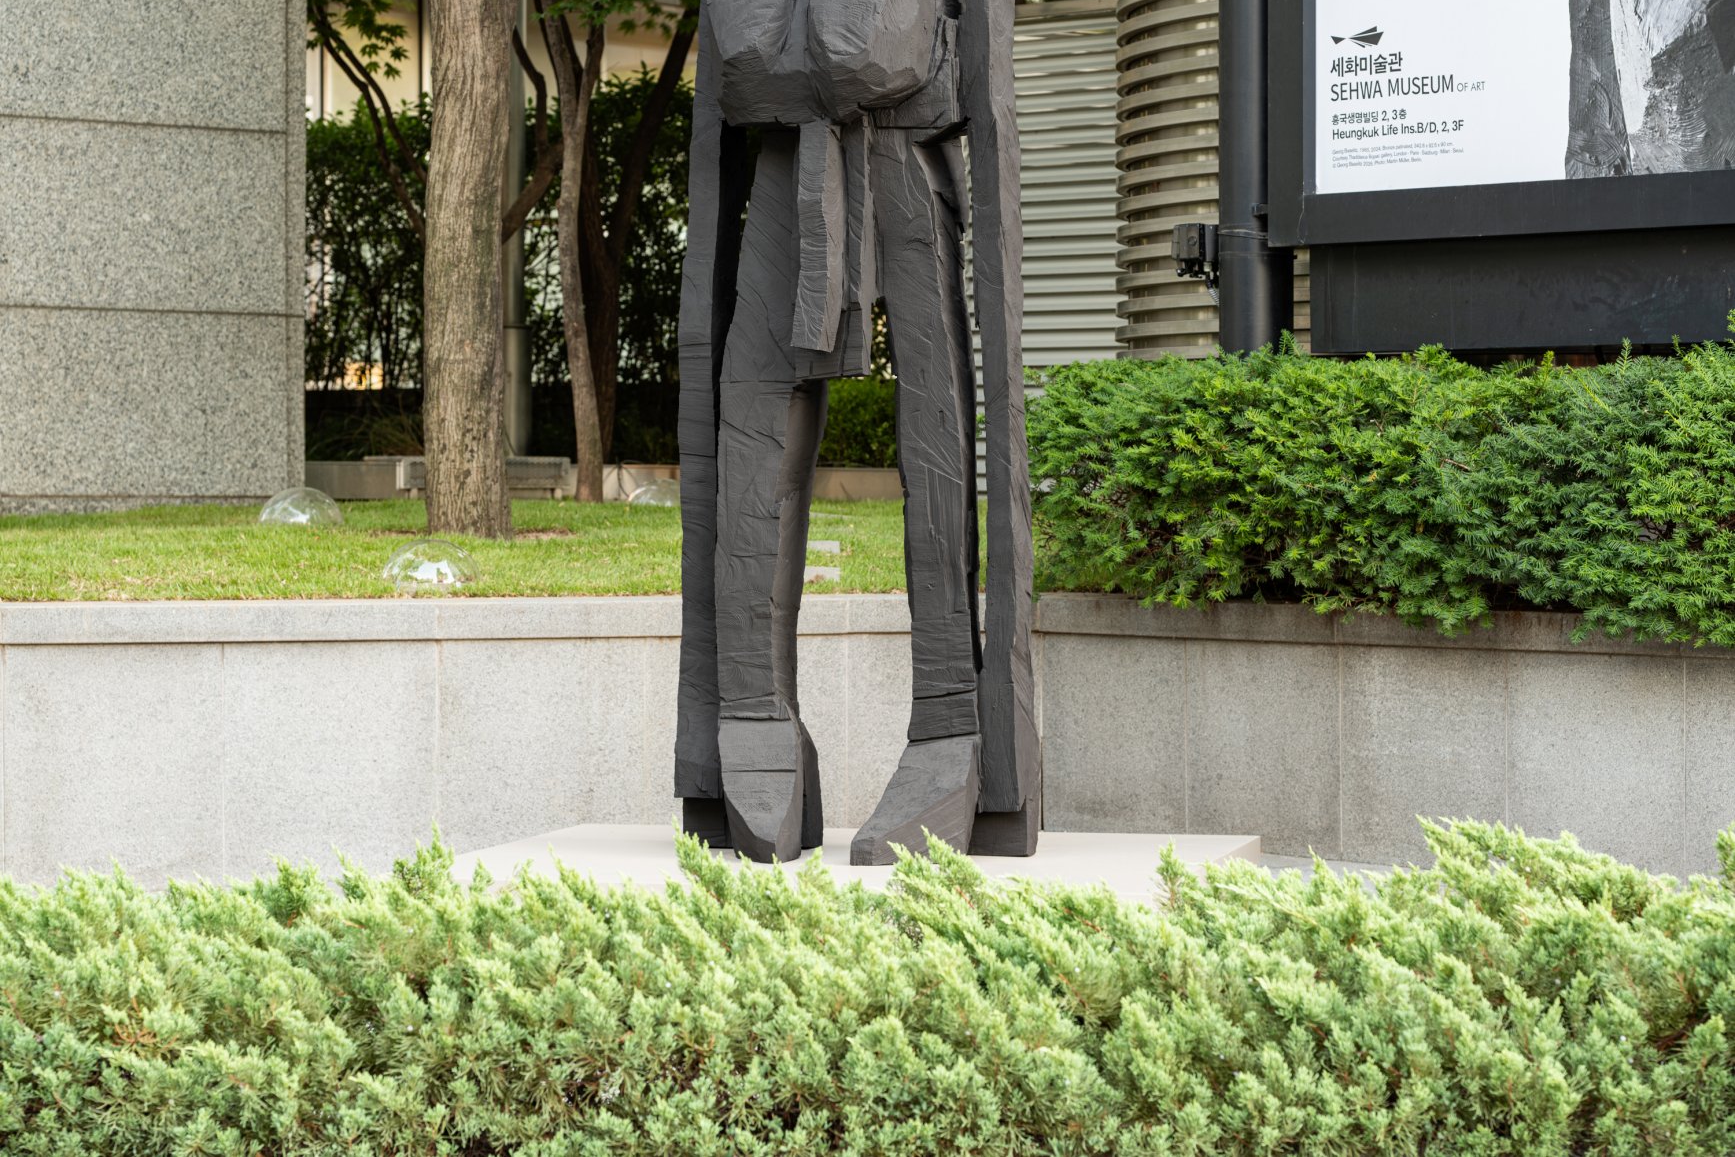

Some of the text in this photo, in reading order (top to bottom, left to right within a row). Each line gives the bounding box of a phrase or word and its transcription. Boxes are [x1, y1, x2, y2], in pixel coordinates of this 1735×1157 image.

[1329, 51, 1403, 78] 세화미술관
[1330, 74, 1486, 102] SEHWA MUSEUM OF ART
[1381, 110, 1390, 122] 2,
[1332, 125, 1380, 141] Heungkuk
[1381, 123, 1399, 136] Life
[1441, 121, 1450, 133] 2,
[1452, 119, 1465, 132] 3F
